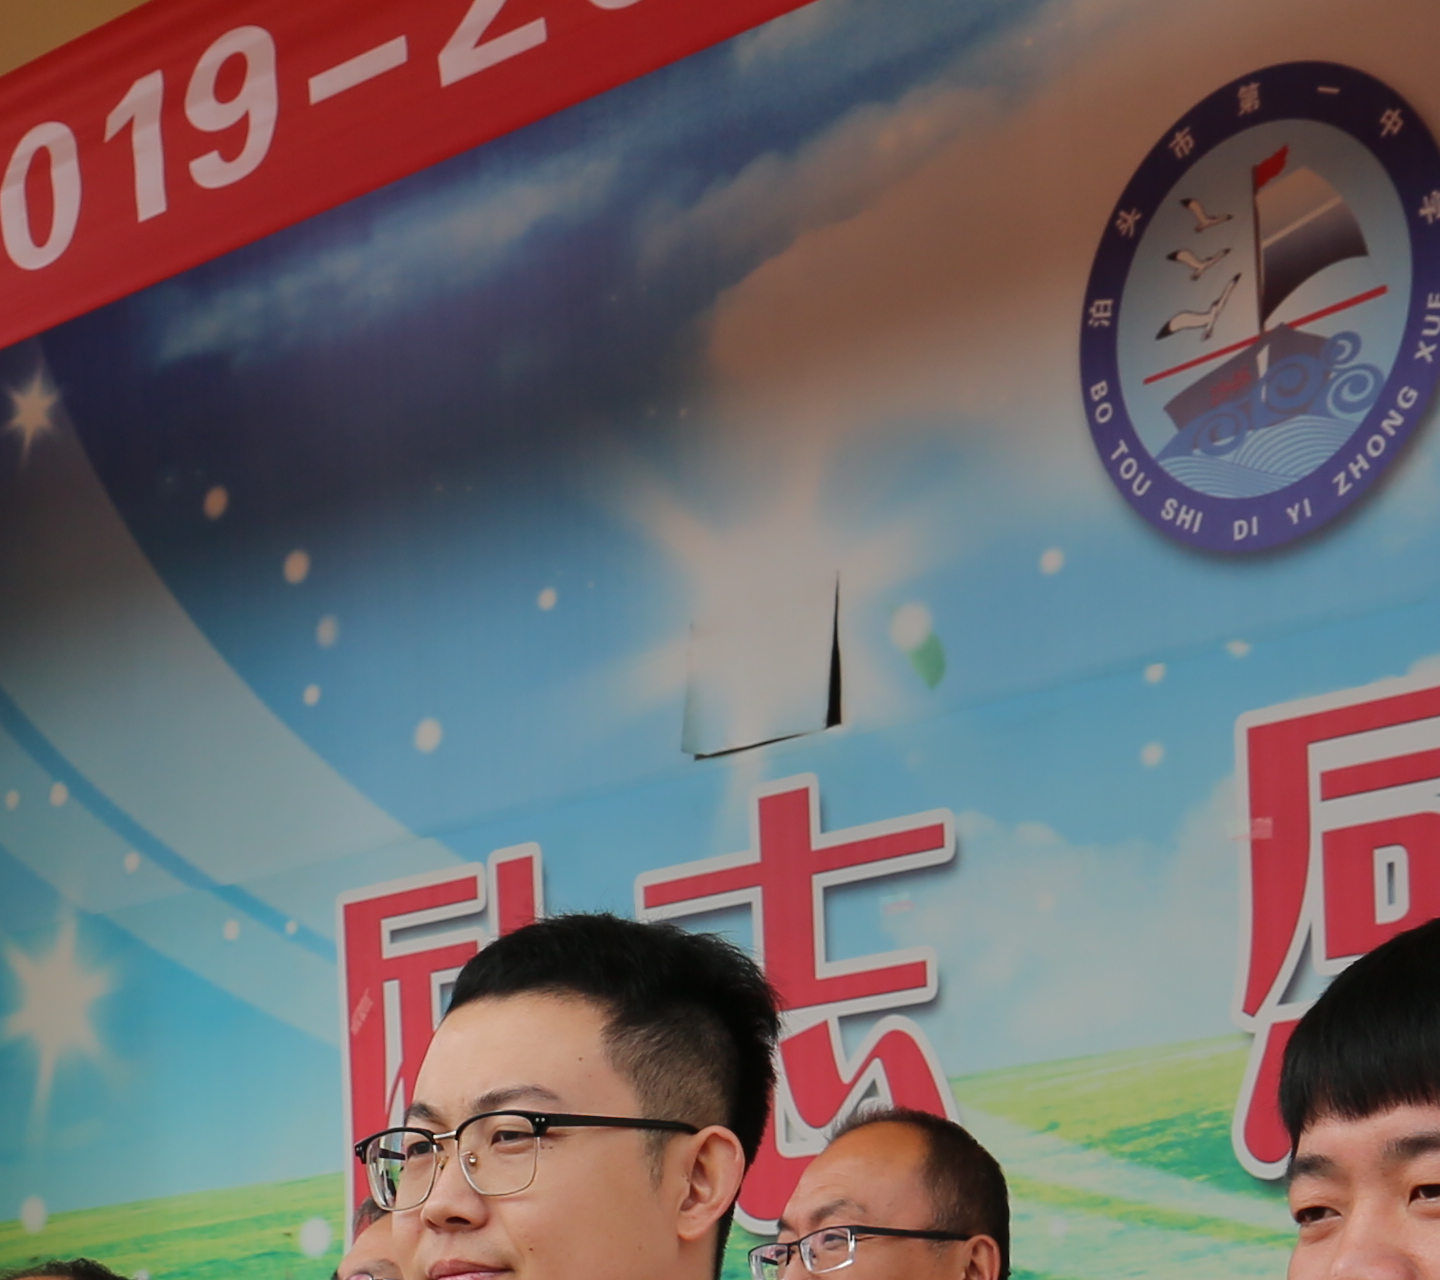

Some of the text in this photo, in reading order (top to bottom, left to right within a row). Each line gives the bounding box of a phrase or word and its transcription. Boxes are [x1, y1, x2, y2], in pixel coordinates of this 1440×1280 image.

[1090, 379, 1114, 424] BO
[1110, 438, 1153, 497] TOU
[1159, 498, 1204, 535] SHI
[1232, 515, 1260, 542] DI
[1286, 497, 1313, 526] YI
[1332, 386, 1419, 497] ZHONG
